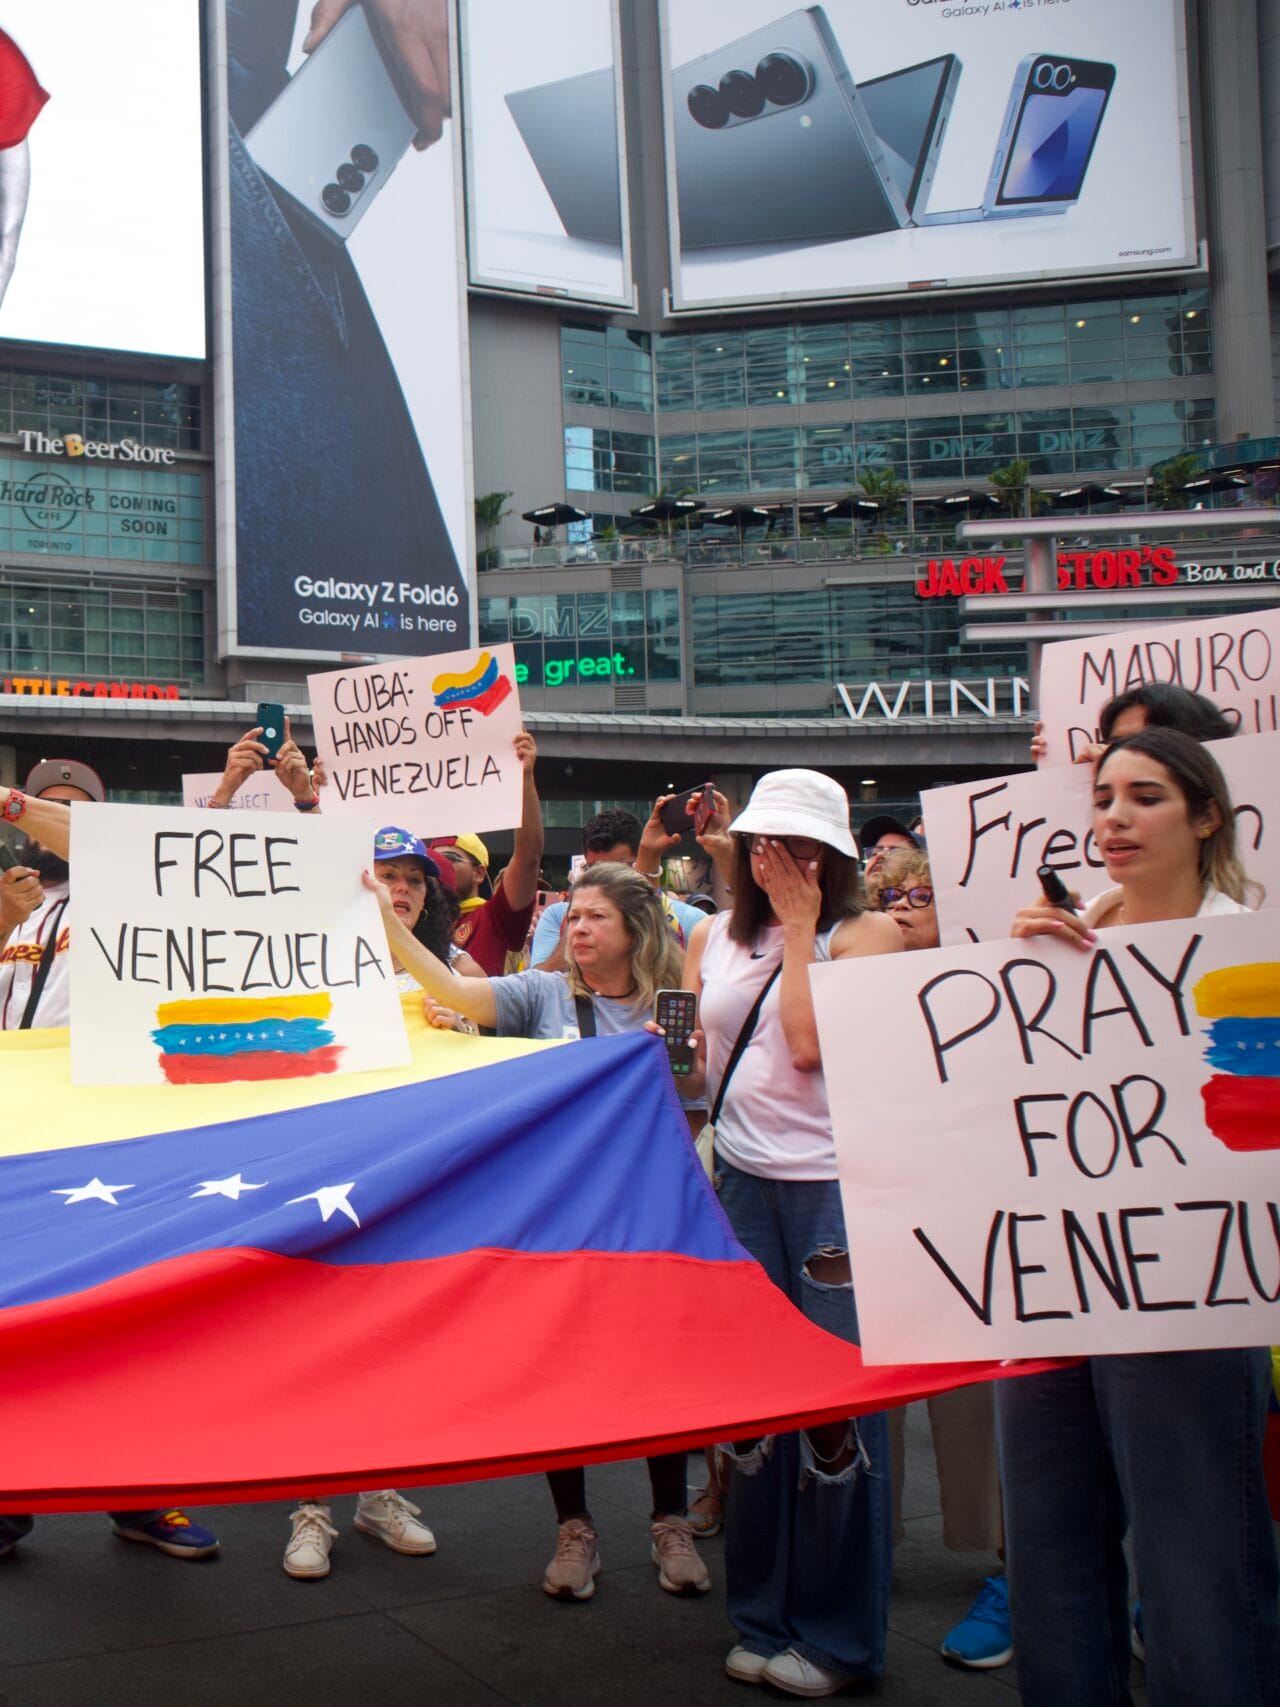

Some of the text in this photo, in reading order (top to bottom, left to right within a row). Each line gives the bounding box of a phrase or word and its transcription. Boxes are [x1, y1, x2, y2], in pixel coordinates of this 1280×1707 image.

[942, 5, 990, 18] Galaxy
[992, 2, 1005, 12] AI
[1119, 247, 1172, 257] samsung.com
[19, 430, 176, 465] The Beer Store
[0, 481, 95, 511] Hard Rock
[109, 495, 176, 514] COMING
[37, 511, 62, 522] CAFE
[121, 518, 168, 536] SOON
[917, 556, 1009, 598] JACK
[1182, 563, 1228, 582] Bar
[294, 576, 459, 607] Galaxy Z Fold6
[299, 608, 457, 632] Galaxy AI is here
[511, 604, 609, 639] DMZ
[545, 652, 634, 686] great.
[1080, 628, 1272, 705] MADURO
[71, 682, 180, 700] CANADA
[334, 672, 413, 714] CUBA:
[331, 709, 473, 756] HANDS OFF
[333, 754, 502, 801] VENEZUELA
[155, 829, 301, 898] FREE
[91, 922, 386, 992] VENEZUELA
[918, 934, 1203, 1083] PRAY
[1014, 1074, 1187, 1178] FOR
[913, 1200, 1280, 1326] VENEZU
